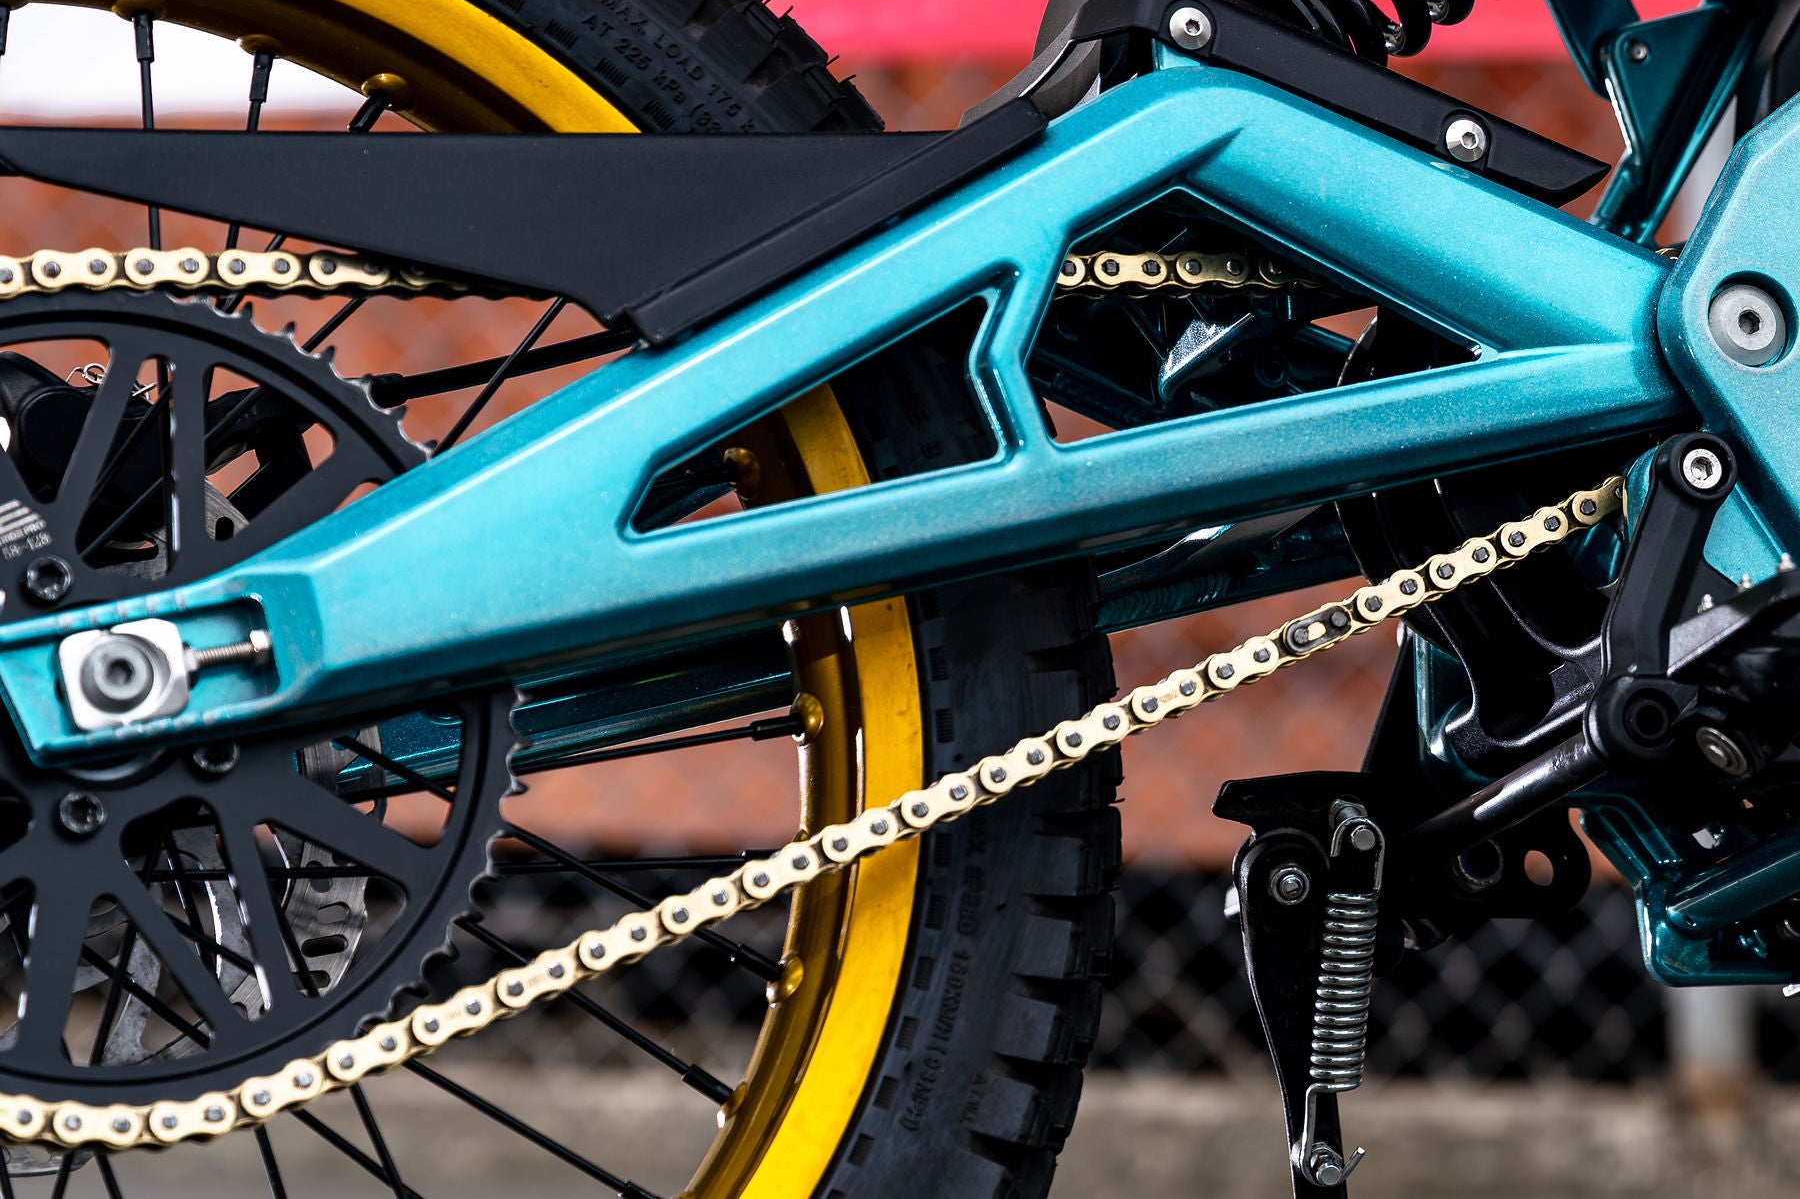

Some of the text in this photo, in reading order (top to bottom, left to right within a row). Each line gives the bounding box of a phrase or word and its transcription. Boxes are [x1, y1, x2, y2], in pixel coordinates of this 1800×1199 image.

[582, 13, 616, 38] AT
[614, 38, 653, 70] 225
[652, 69, 688, 105] kPa
[653, 33, 705, 81] LOAD
